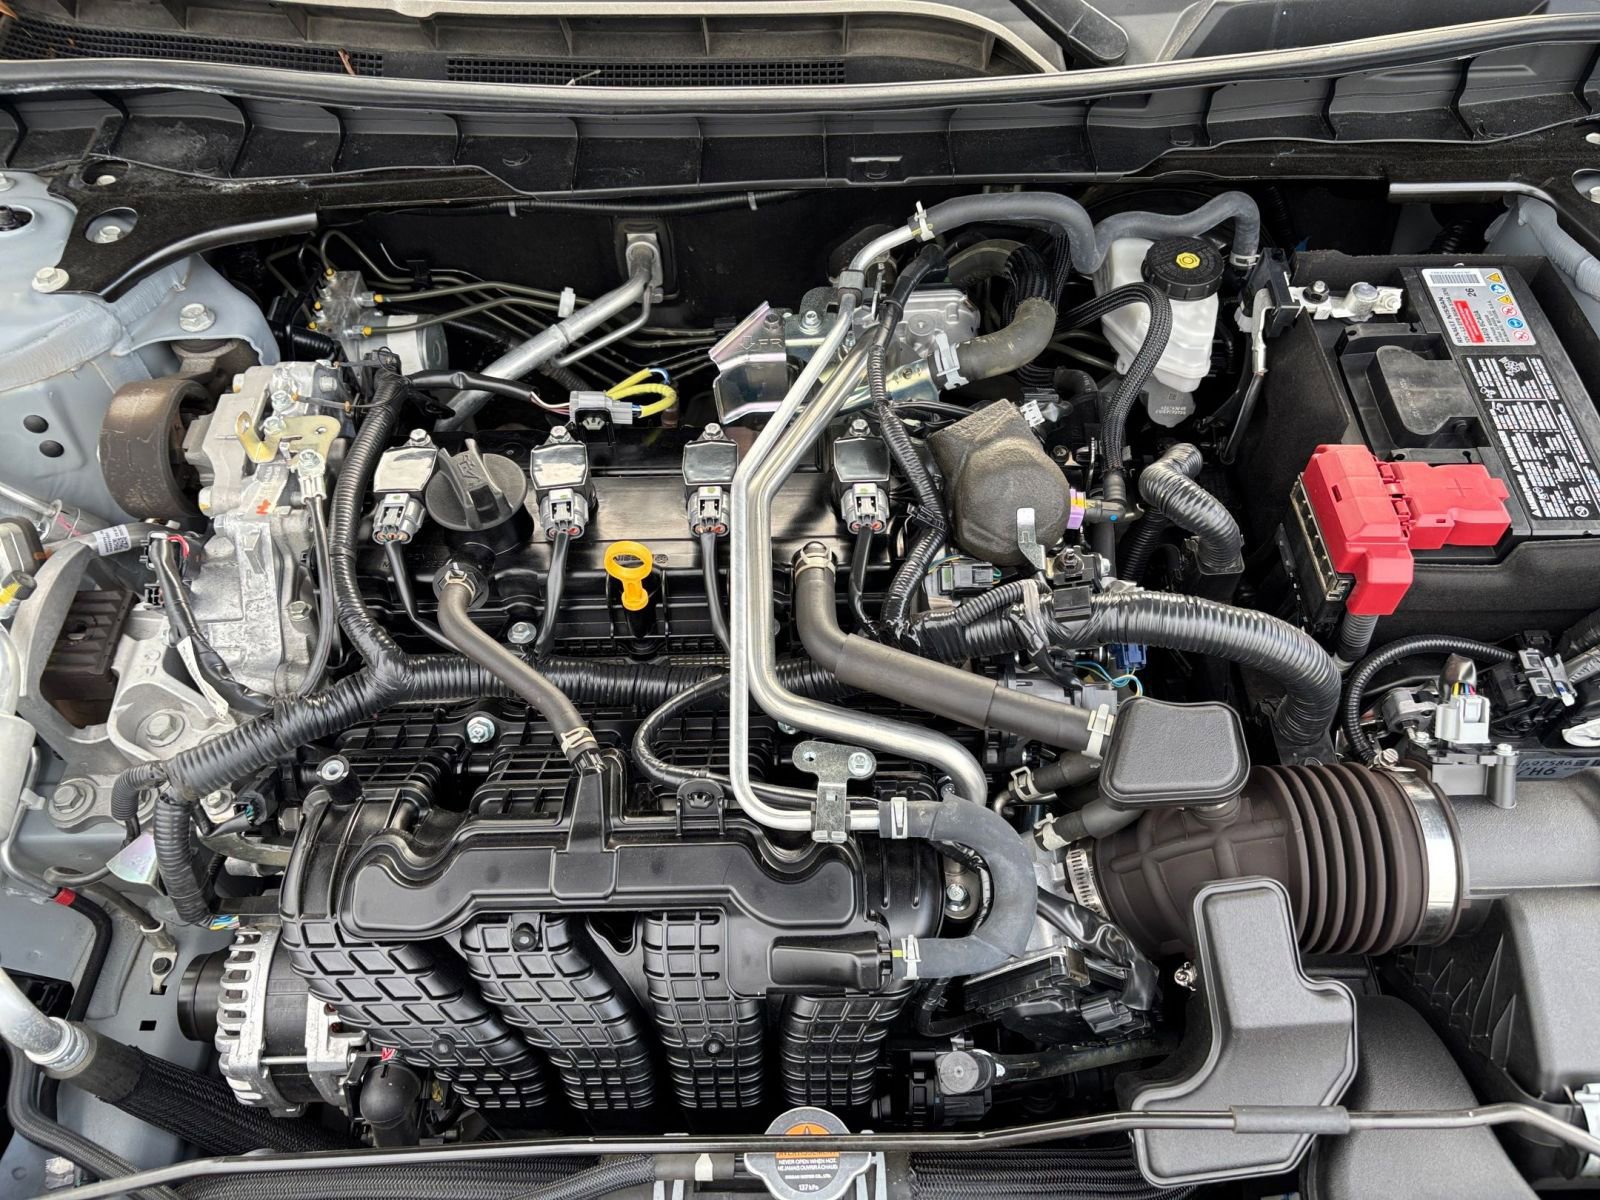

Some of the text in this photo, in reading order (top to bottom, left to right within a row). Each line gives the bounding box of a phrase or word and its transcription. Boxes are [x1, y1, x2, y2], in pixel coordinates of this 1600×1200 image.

[1464, 288, 1476, 296] 26
[1438, 297, 1462, 343] RENAULT NISSAN
